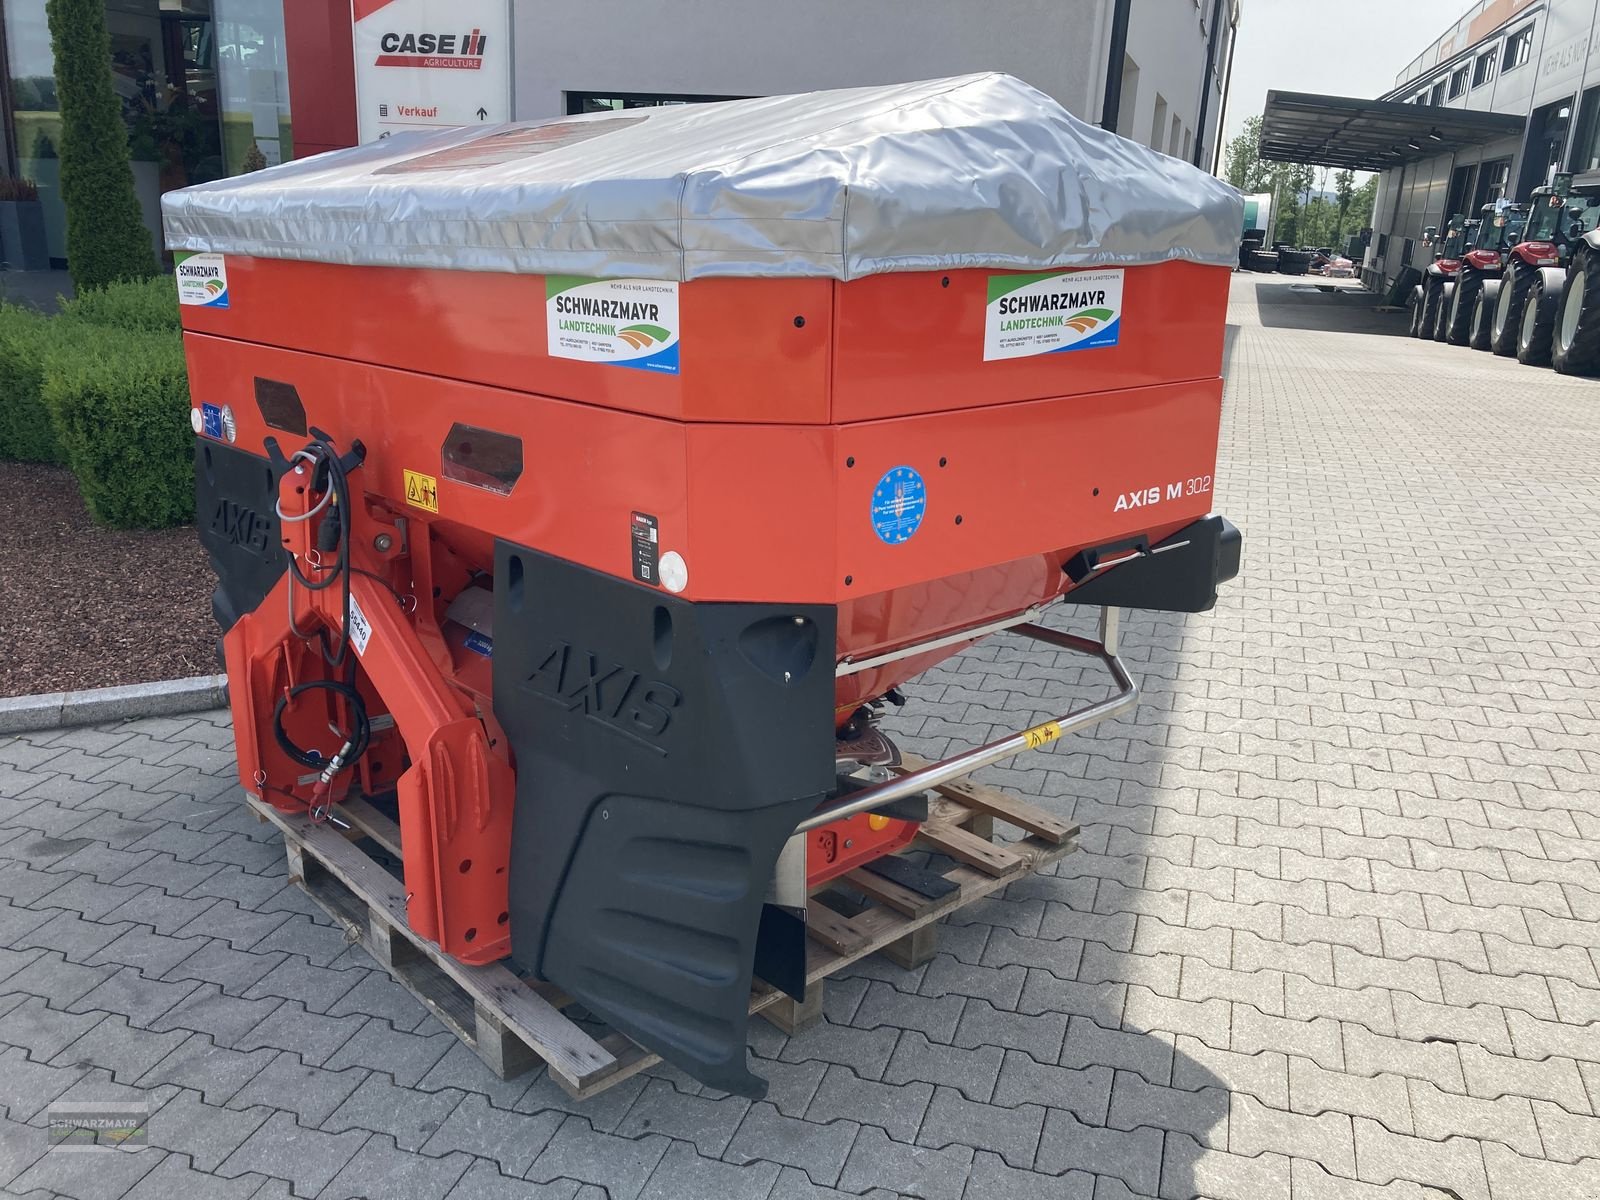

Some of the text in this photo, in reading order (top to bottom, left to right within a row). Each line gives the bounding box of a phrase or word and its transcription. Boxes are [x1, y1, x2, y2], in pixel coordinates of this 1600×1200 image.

[381, 33, 456, 54] CASE
[424, 58, 479, 68] AGRICULTURE
[397, 105, 438, 118] Verkauf
[179, 265, 219, 277] SCHWARZMAYR
[556, 295, 659, 322] SCHWARZMAYR
[999, 290, 1106, 316] SCHWARZMAYR
[559, 319, 617, 336] LANDTECHNIK
[1000, 315, 1064, 332] LANDTECHNIK
[1113, 486, 1160, 512] AXIS
[1166, 481, 1183, 501] M
[210, 497, 271, 551] AXIS
[350, 610, 366, 640] 55440
[520, 640, 683, 737] AXIS
